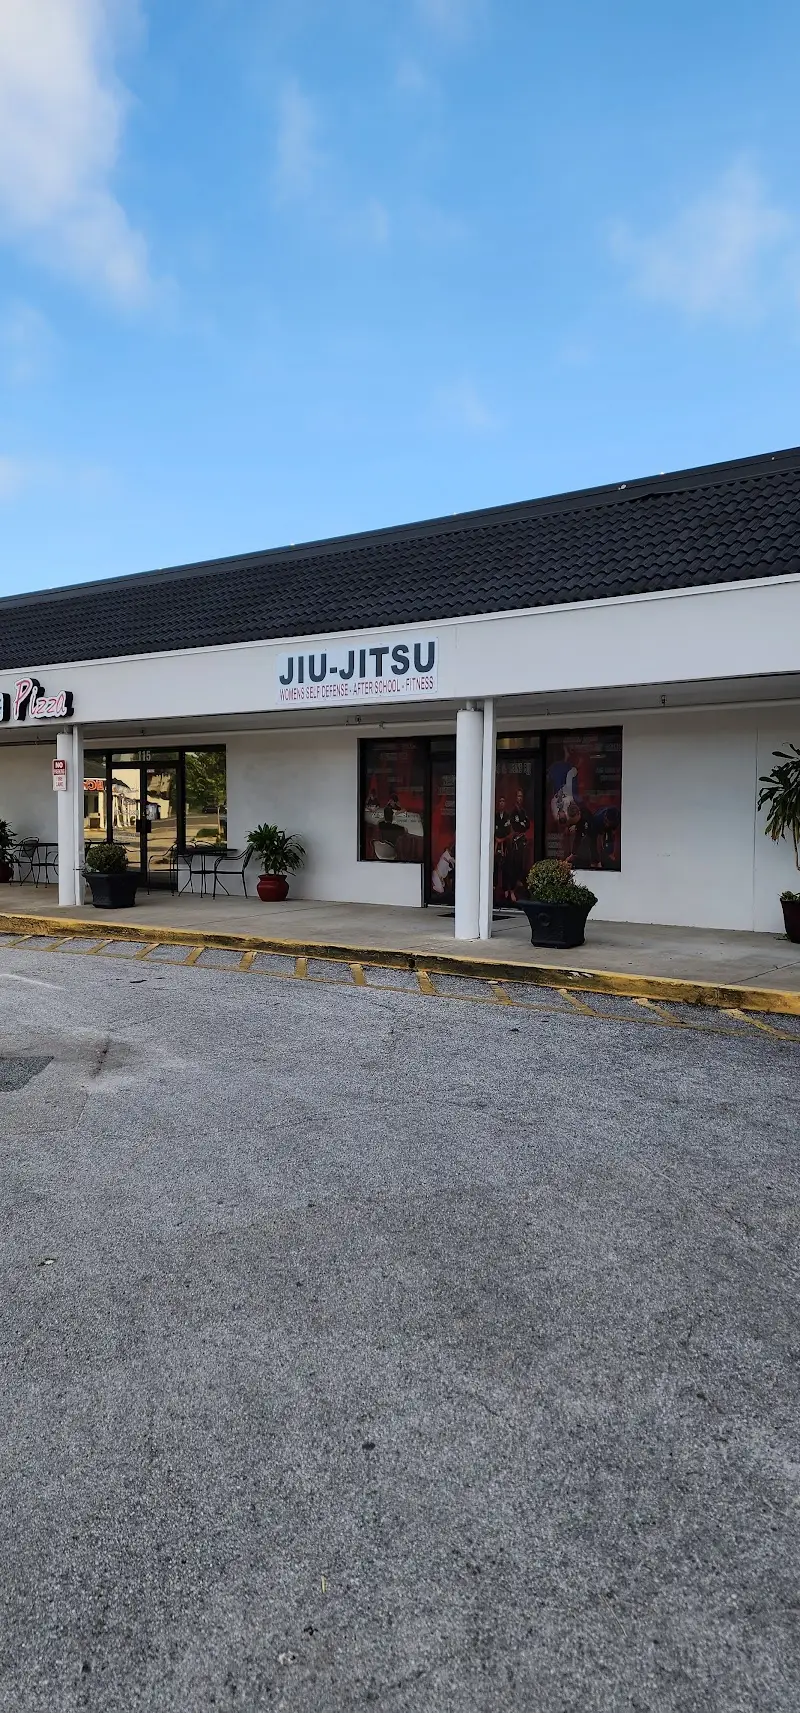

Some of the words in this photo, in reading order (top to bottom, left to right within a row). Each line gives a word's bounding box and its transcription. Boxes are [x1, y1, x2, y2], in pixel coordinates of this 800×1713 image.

[279, 641, 435, 685] JIU-JITSU
[14, 677, 72, 721] Pizza
[279, 686, 305, 701] WOMENS
[305, 684, 321, 699] SELF
[321, 682, 349, 698] DEFENSE
[352, 681, 374, 696] AFTER
[374, 678, 401, 694] SCHOOL
[405, 676, 435, 692] FITNESS
[55, 761, 64, 769] NO
[138, 751, 151, 761] 115
